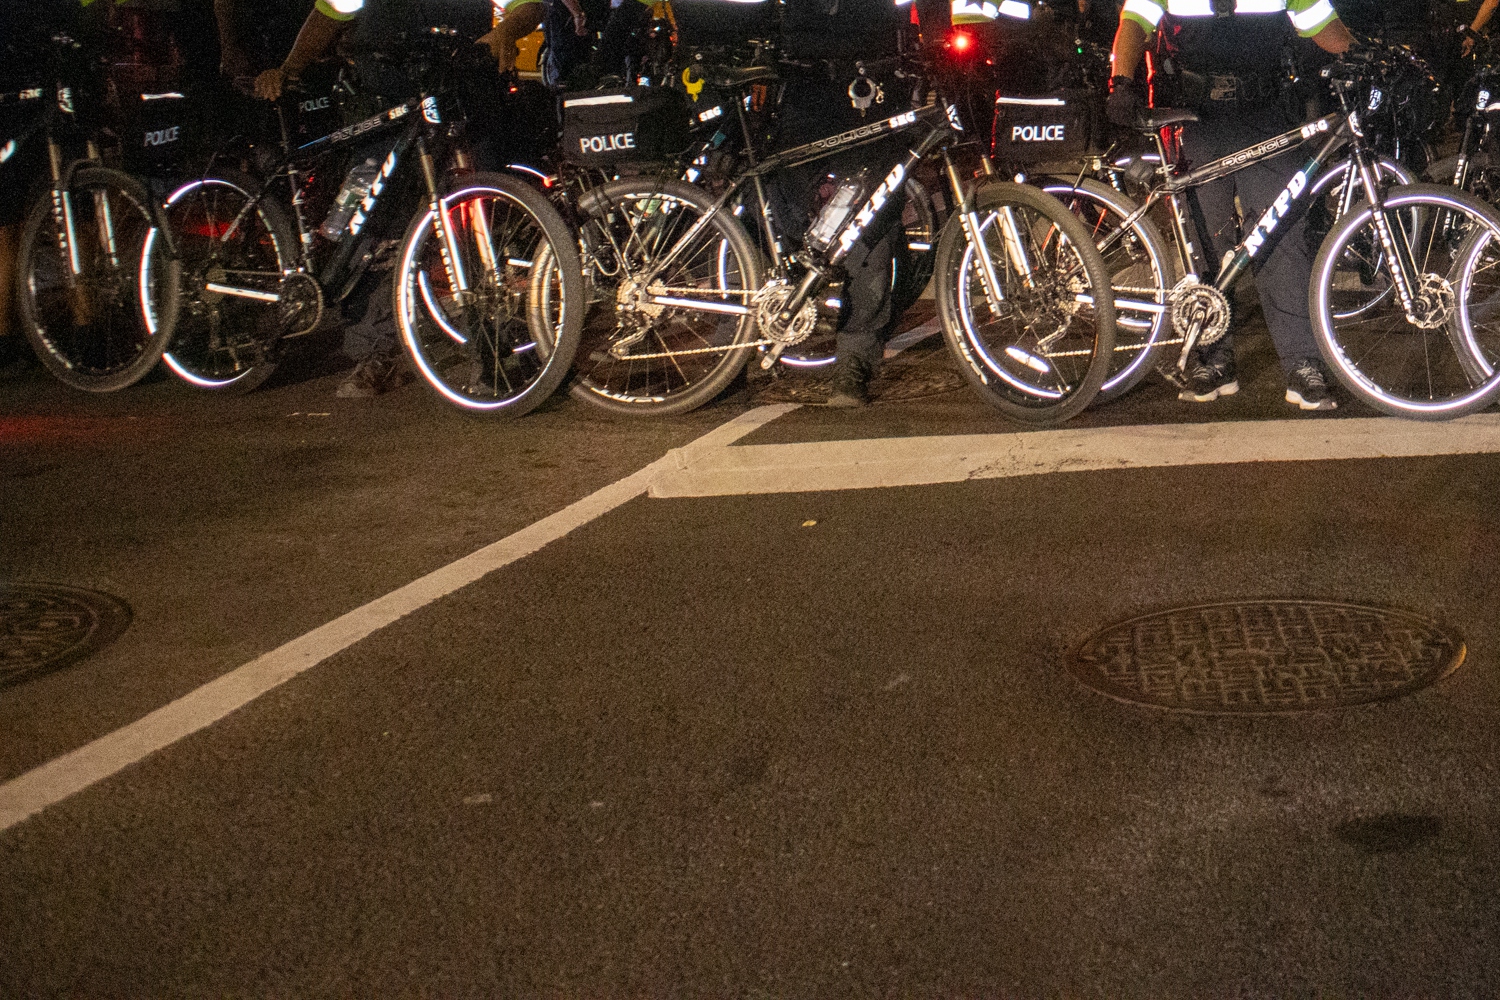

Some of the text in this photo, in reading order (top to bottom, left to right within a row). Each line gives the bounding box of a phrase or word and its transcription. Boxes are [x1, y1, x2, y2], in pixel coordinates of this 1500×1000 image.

[388, 104, 409, 120] SRG
[699, 105, 723, 122] SRG
[143, 125, 180, 147] POLICE
[579, 132, 636, 154] POLICE
[811, 110, 916, 150] POLICE SRG
[1011, 124, 1065, 141] POLICE
[1222, 137, 1289, 168] POLICE
[839, 163, 904, 251] NYPD
[1244, 170, 1307, 257] NYPD
[1374, 209, 1412, 311] NYPD POLICE
